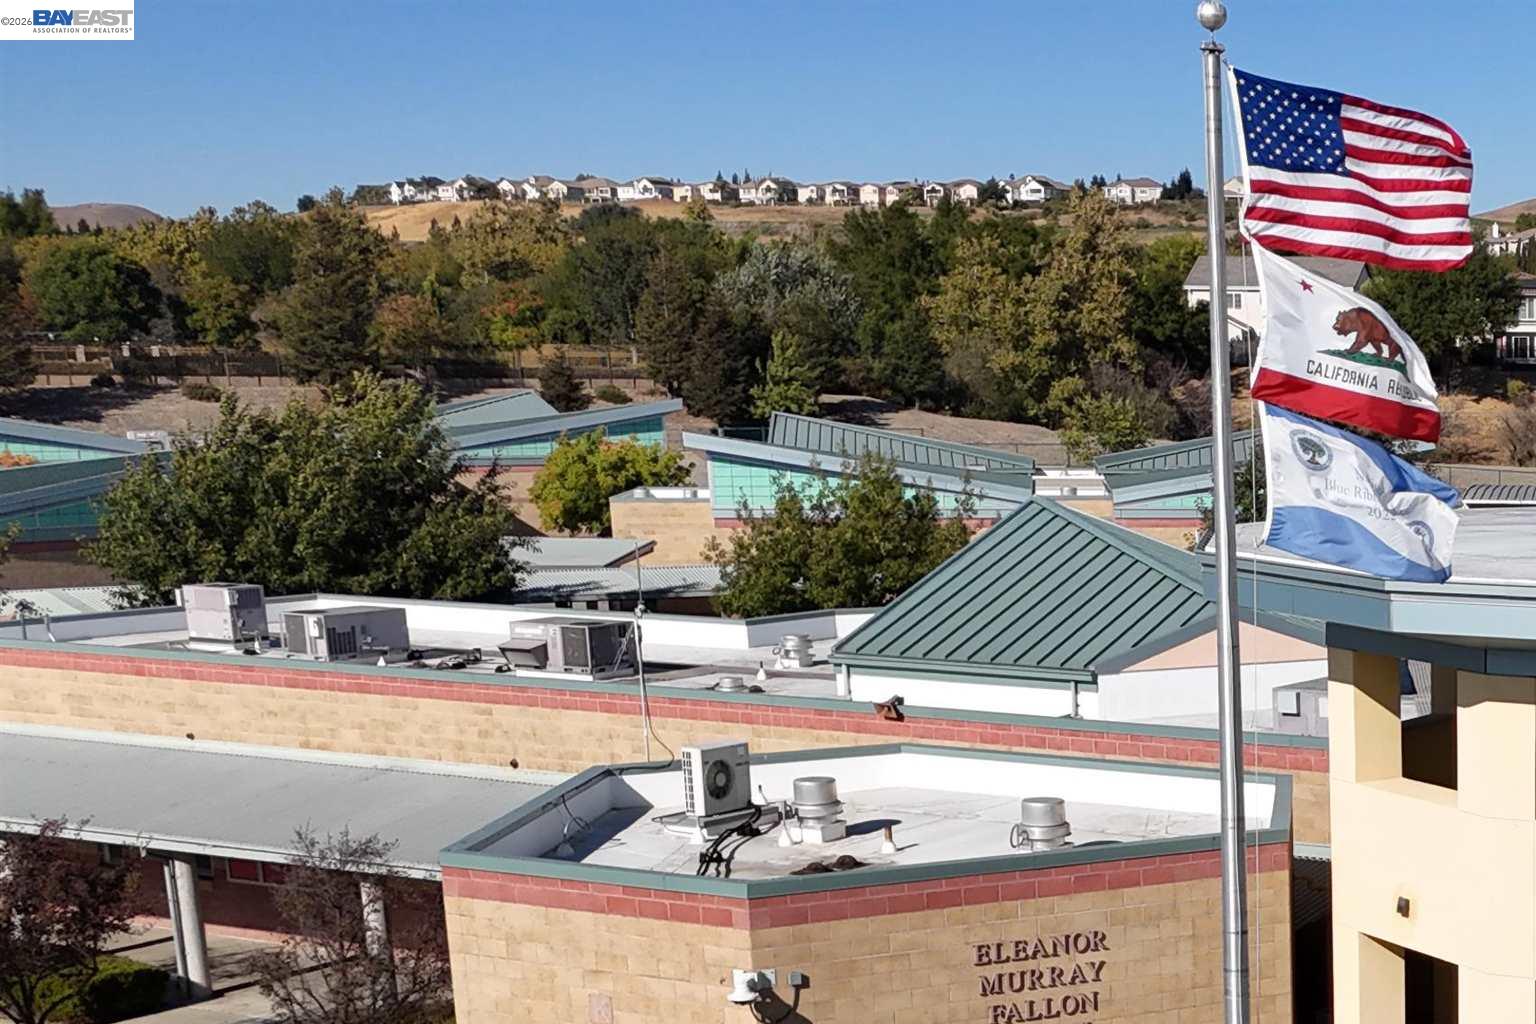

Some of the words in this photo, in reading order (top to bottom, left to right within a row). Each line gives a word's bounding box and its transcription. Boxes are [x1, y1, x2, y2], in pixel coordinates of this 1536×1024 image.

[1306, 359, 1378, 391] CALIFORNIA
[973, 930, 1111, 967] ELEANOR
[978, 960, 1107, 997] MURRAY
